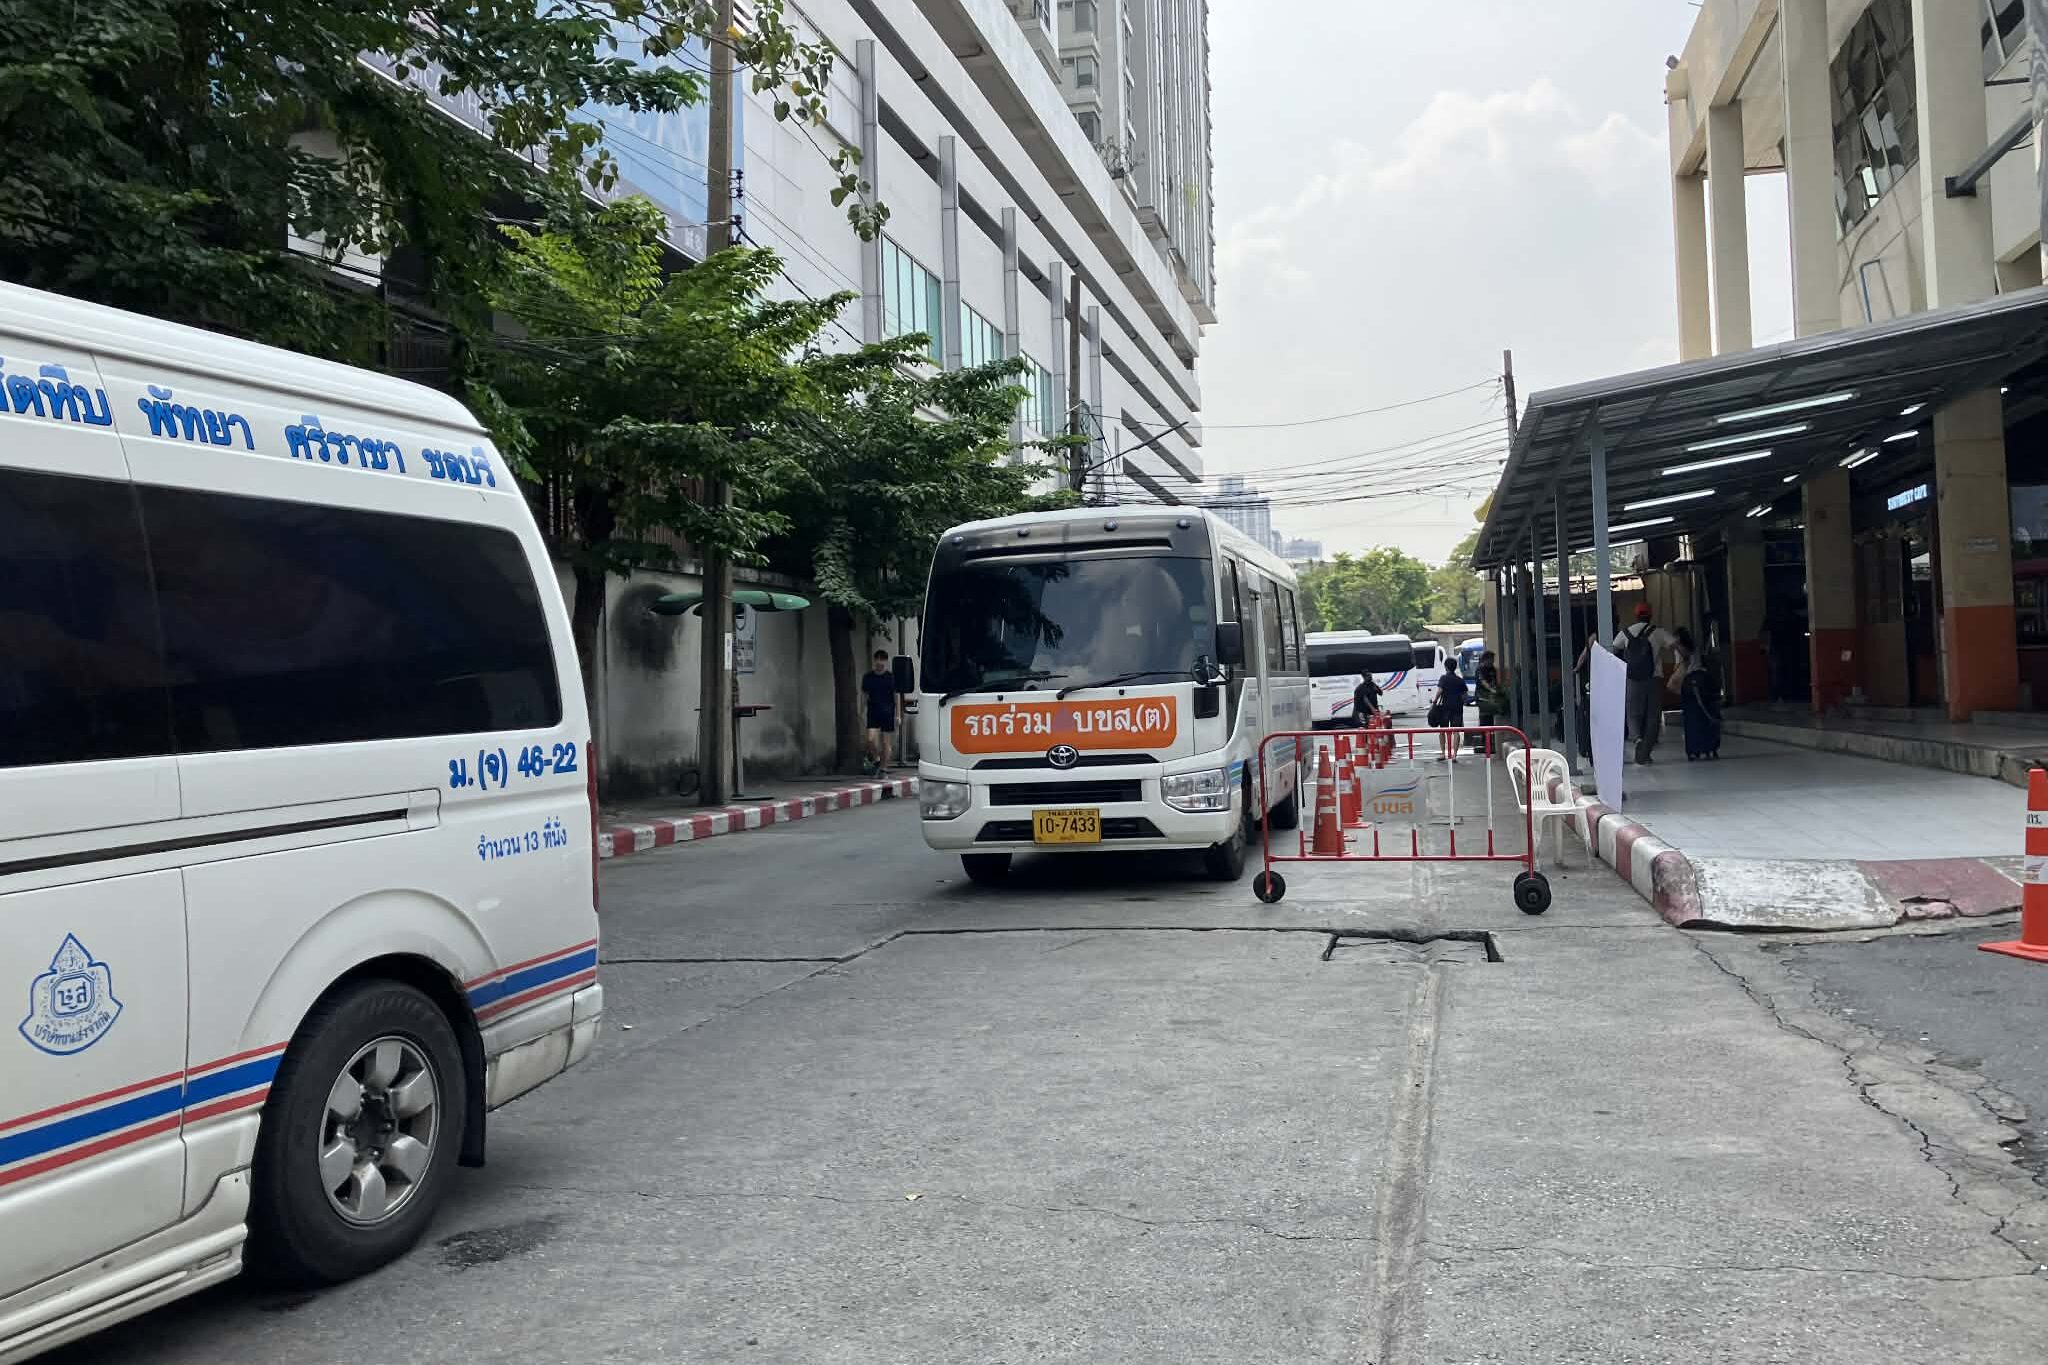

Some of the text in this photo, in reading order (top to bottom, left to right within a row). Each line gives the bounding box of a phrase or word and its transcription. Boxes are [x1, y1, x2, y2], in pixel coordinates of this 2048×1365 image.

[137, 384, 255, 450] พัทยา
[284, 414, 406, 473] ศรีราชา
[964, 702, 1170, 736] รถร่วม บขส.(ต)
[517, 742, 577, 778] 46-22
[477, 815, 567, 861] จำนวน 13 ที่นั่ง
[1039, 816, 1096, 834] 10-7433
